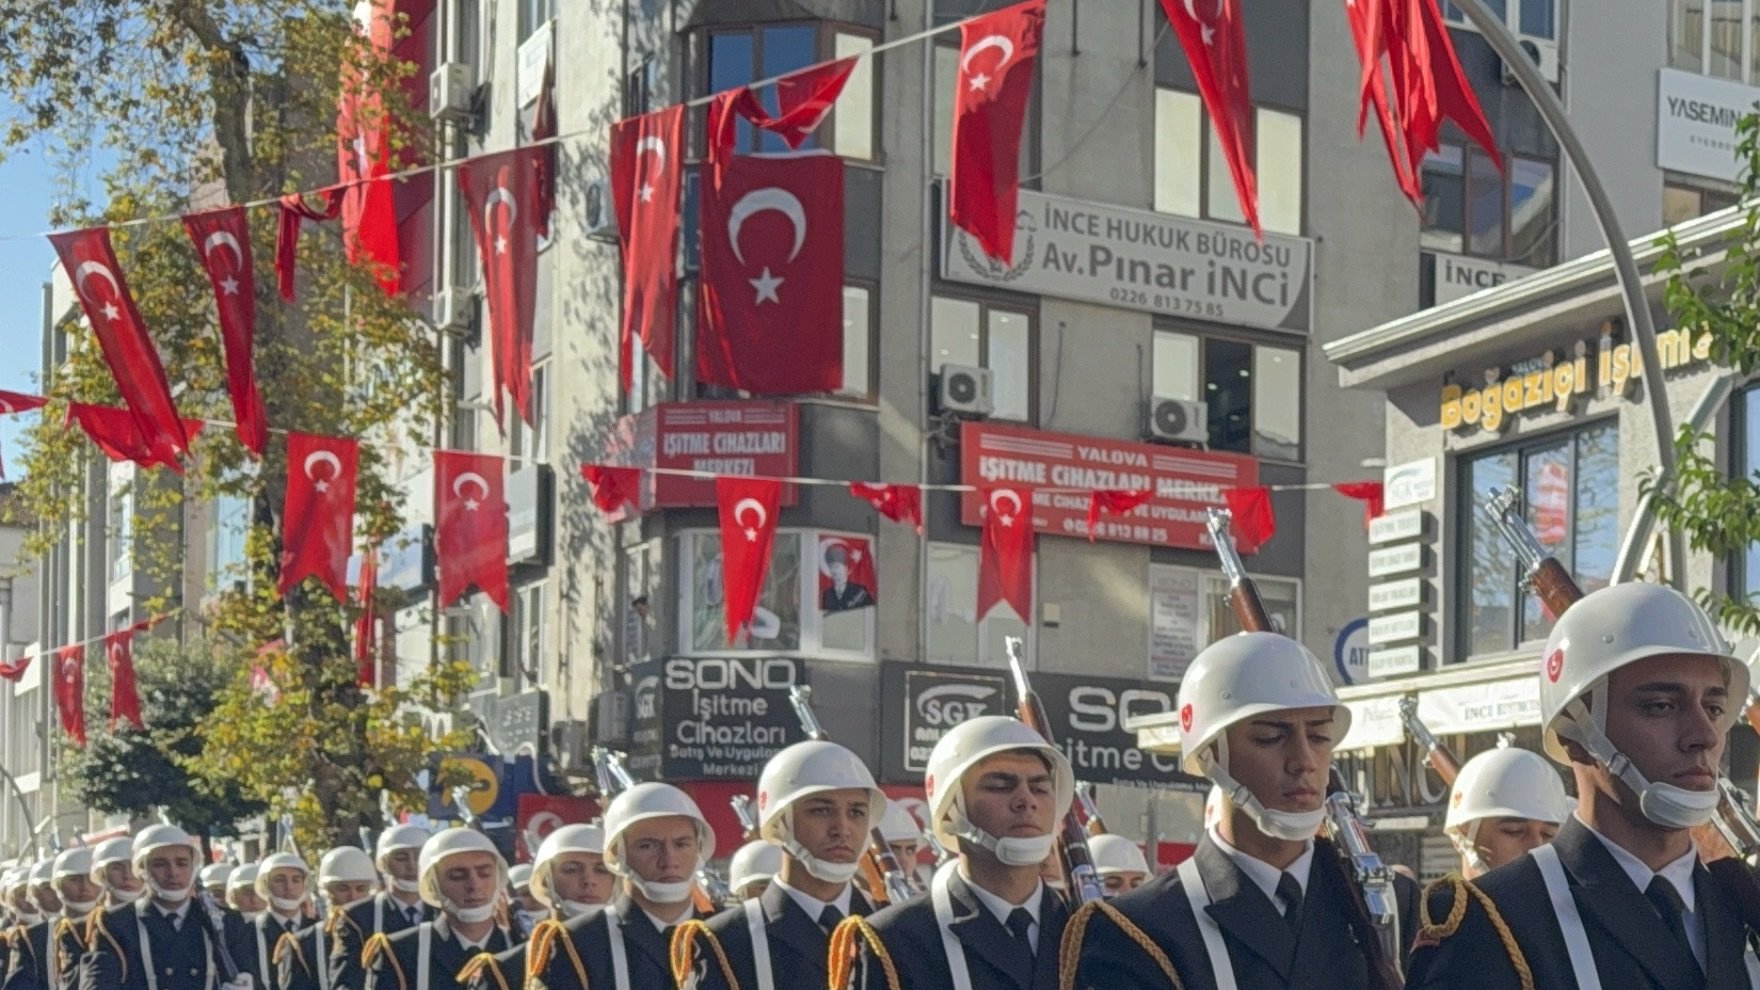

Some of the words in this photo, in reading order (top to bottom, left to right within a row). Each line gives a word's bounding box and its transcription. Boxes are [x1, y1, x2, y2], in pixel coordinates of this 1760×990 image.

[1044, 202, 1100, 237] İNCE
[1107, 217, 1191, 251] HUKUK
[1196, 228, 1291, 268] BÜROSU
[1110, 287, 1147, 305] 0226
[1153, 294, 1182, 312] 813
[1183, 297, 1202, 314] 75
[1206, 301, 1225, 317] 85
[1077, 446, 1148, 468] YALOVA
[666, 659, 796, 690] SONO
[692, 687, 768, 720] İşitme
[925, 699, 988, 726] SGK
[707, 745, 724, 759] Ve
[1054, 738, 1143, 770] itme
[703, 762, 758, 777] Merkezi
